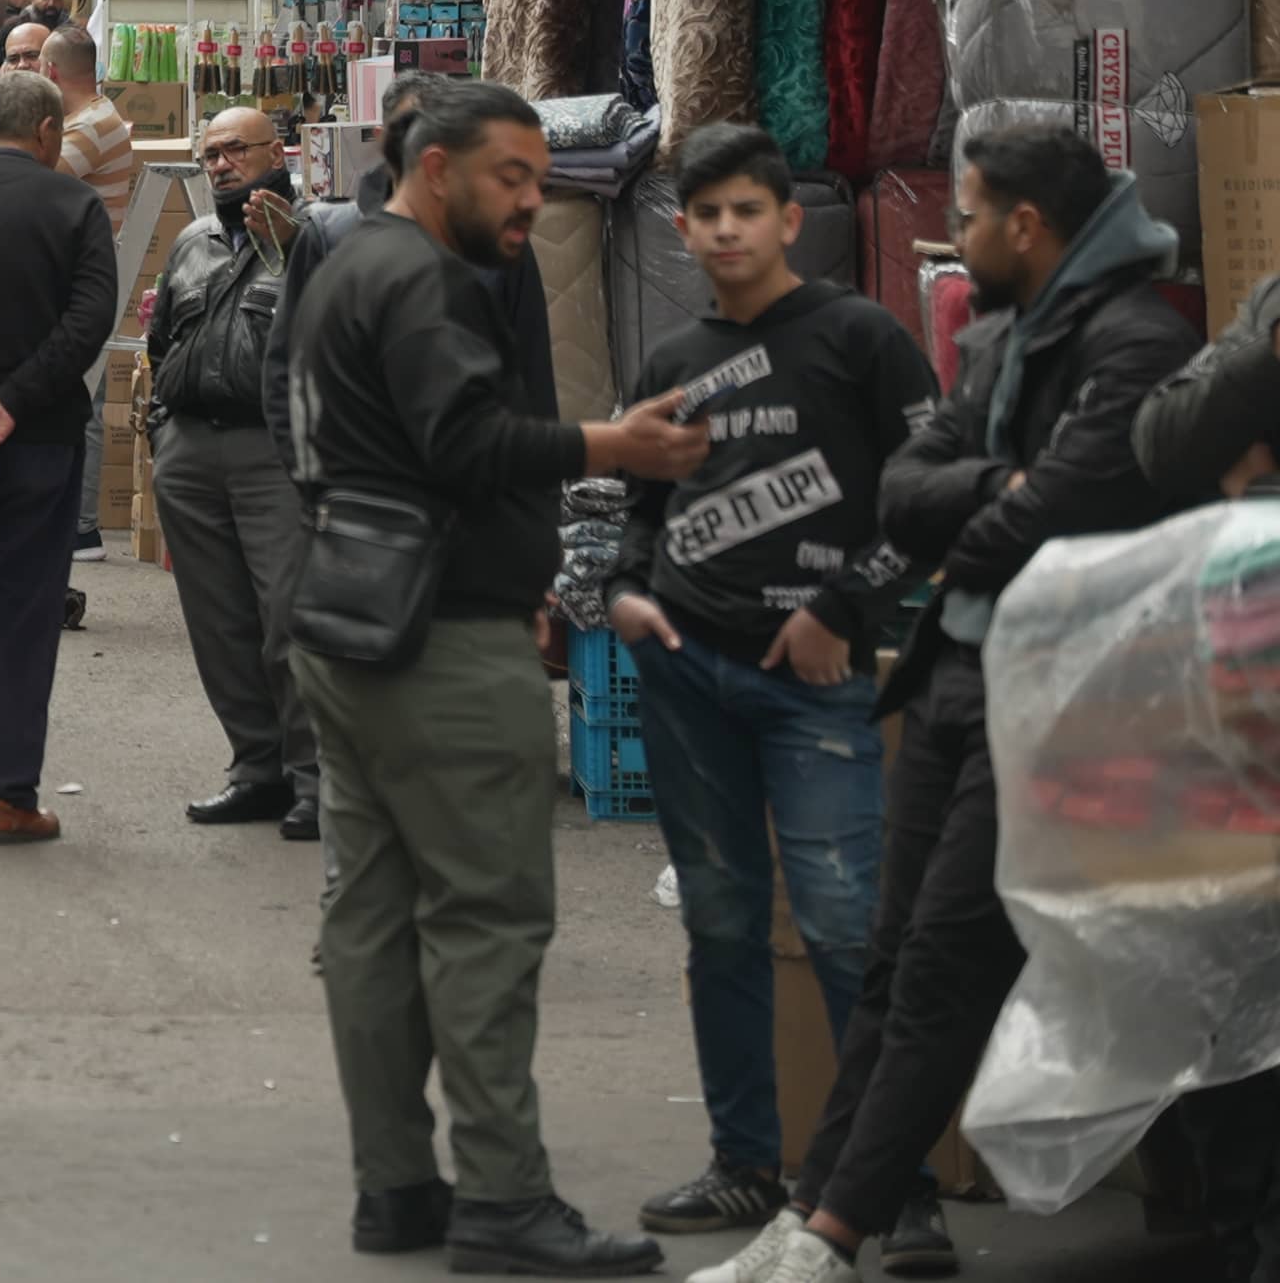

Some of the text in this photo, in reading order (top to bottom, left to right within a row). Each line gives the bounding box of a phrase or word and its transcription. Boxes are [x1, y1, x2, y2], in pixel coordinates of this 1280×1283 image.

[1102, 33, 1122, 170] CRYSTAL PLU
[729, 407, 752, 438] UP
[752, 405, 798, 435] AND
[674, 505, 726, 554] EEP
[730, 488, 762, 529] IT
